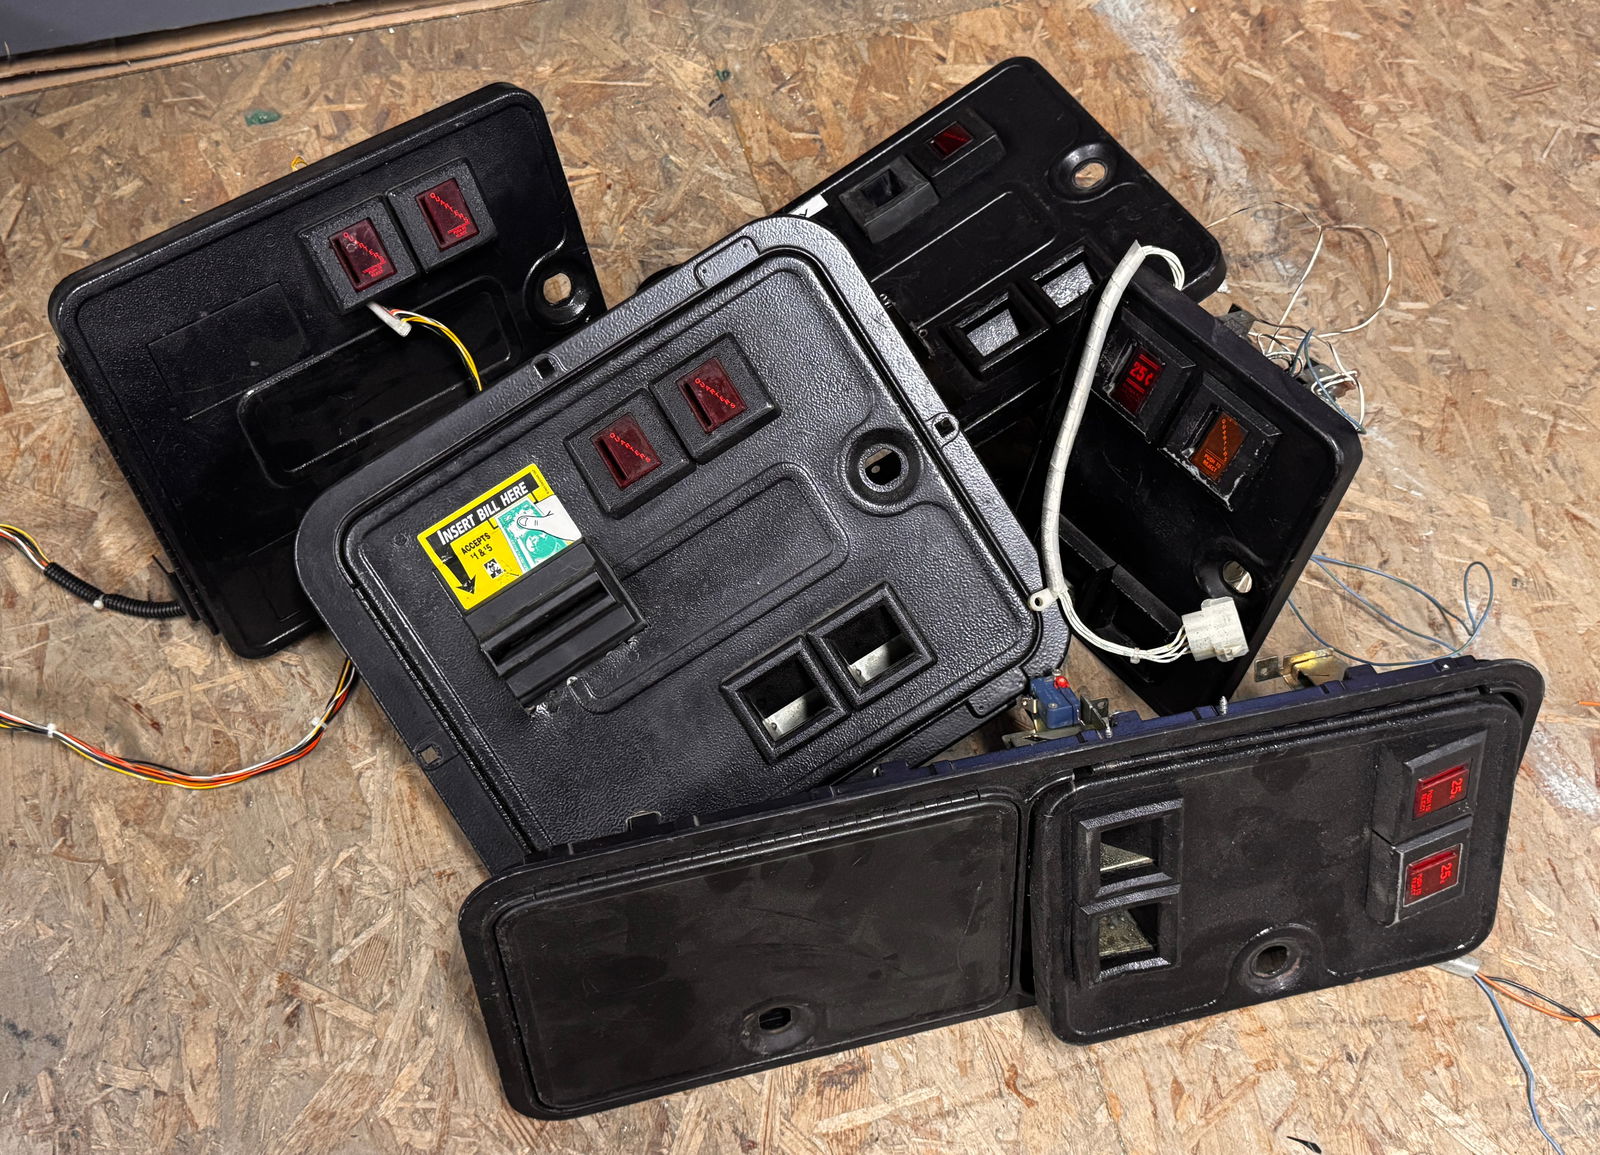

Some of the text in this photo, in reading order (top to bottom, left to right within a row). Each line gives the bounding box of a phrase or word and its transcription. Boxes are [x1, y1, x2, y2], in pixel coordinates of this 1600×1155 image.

[694, 377, 736, 409] QUARTERS
[609, 432, 651, 463] QUARTERS
[436, 513, 476, 546] INSERT
[476, 500, 501, 522] BILL
[500, 481, 529, 507] HERE
[460, 532, 491, 555] ACCEPTS
